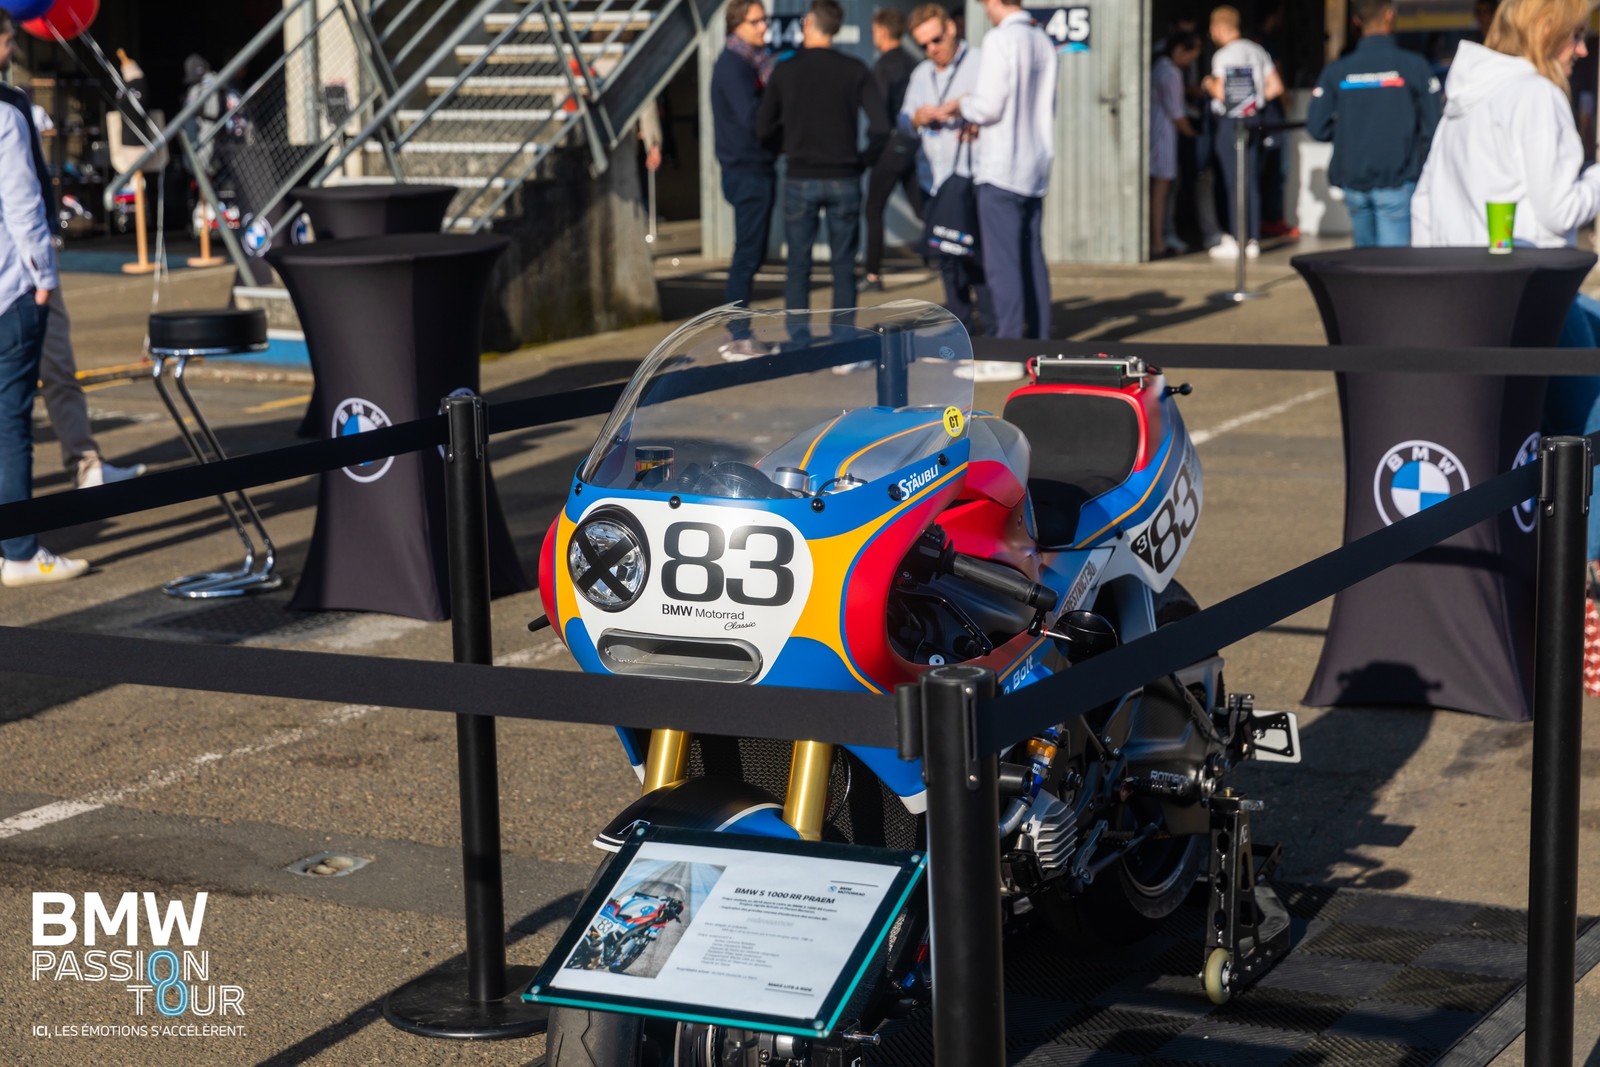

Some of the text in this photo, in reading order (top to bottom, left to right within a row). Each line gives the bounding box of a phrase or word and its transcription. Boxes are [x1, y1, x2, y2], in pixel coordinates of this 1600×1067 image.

[1045, 8, 1089, 41] 45
[339, 402, 384, 426] BMW
[949, 415, 959, 428] CT
[1386, 446, 1456, 475] BMW
[898, 464, 939, 501] STÄUBLI
[1150, 463, 1199, 574] 83
[661, 521, 795, 606] 83
[662, 603, 745, 621] BMW Motorrad
[724, 621, 757, 631] Classic
[734, 887, 836, 904] BMW S 1000 RR PRAEM
